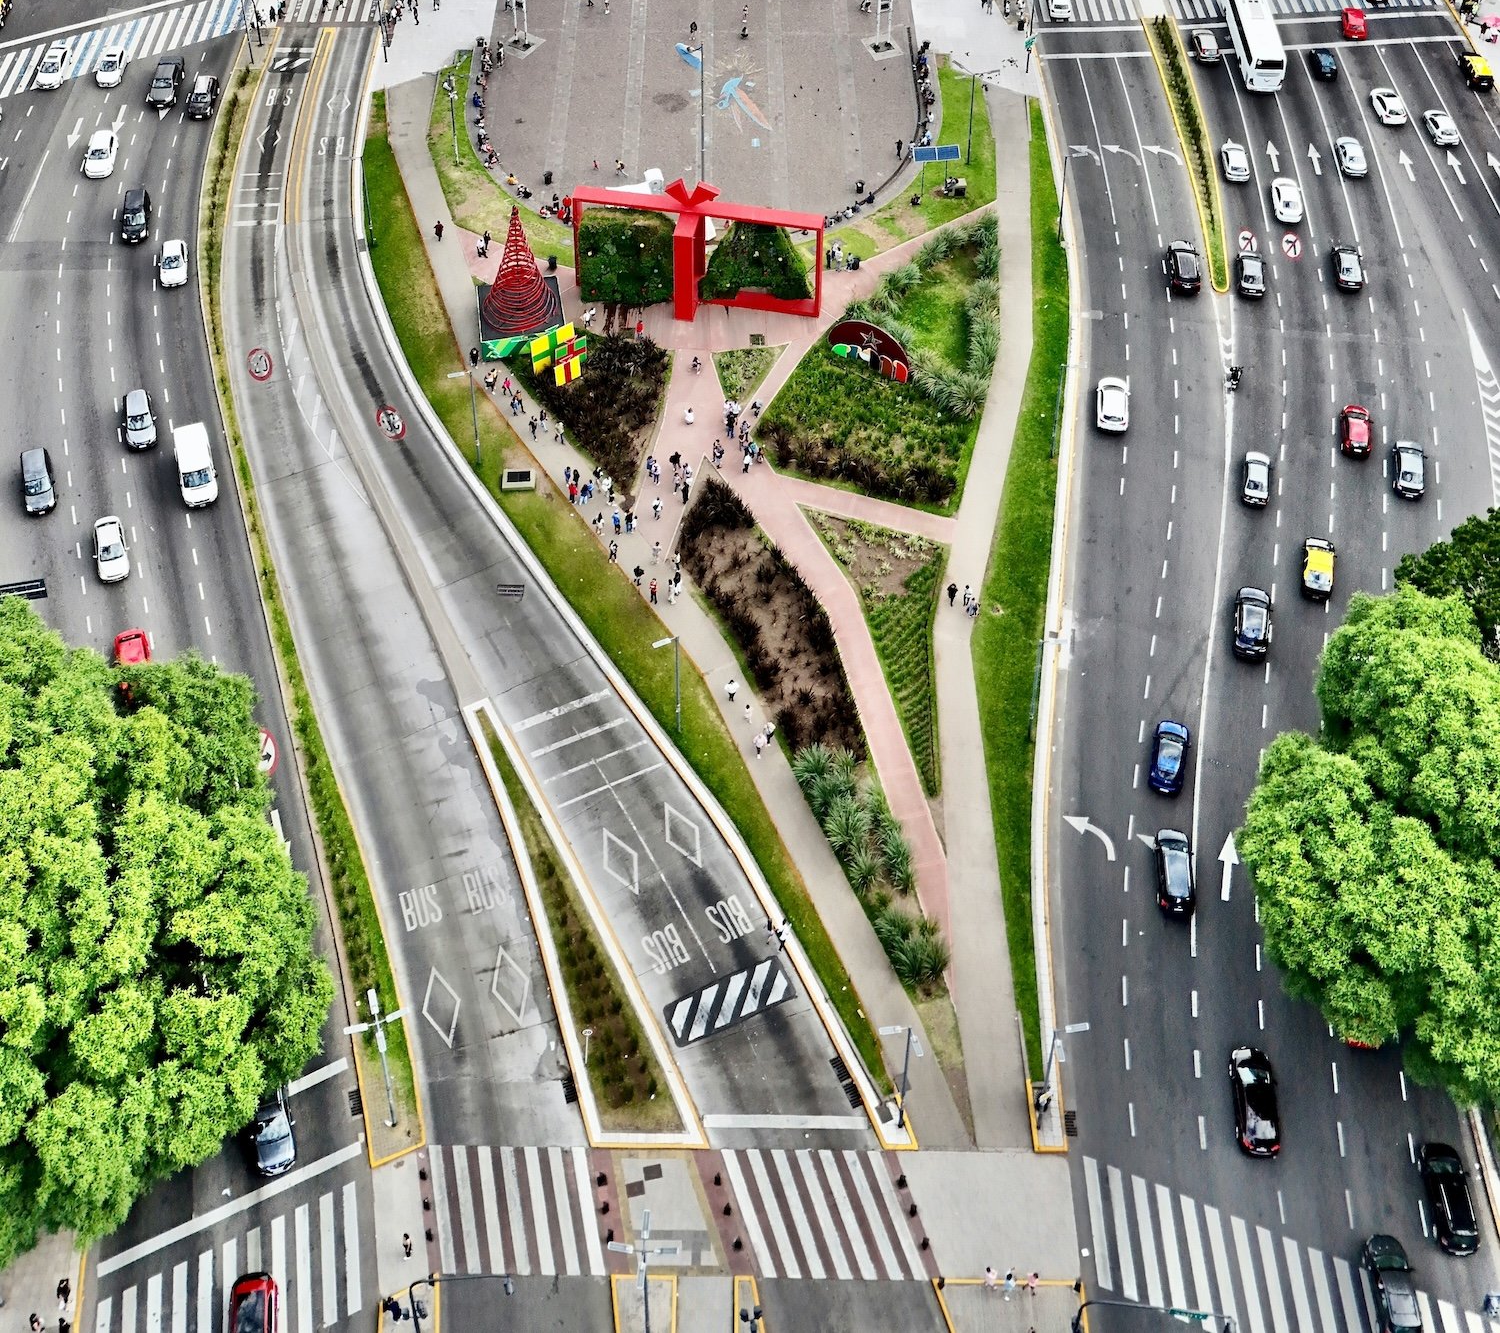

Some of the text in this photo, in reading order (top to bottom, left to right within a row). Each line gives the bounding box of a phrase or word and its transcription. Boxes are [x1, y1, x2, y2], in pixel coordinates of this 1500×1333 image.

[265, 87, 294, 107] BS
[318, 136, 345, 156] BS
[398, 884, 443, 933] BUS
[462, 864, 510, 916] BUS
[705, 894, 756, 945] BUS
[640, 922, 691, 976] BUS
